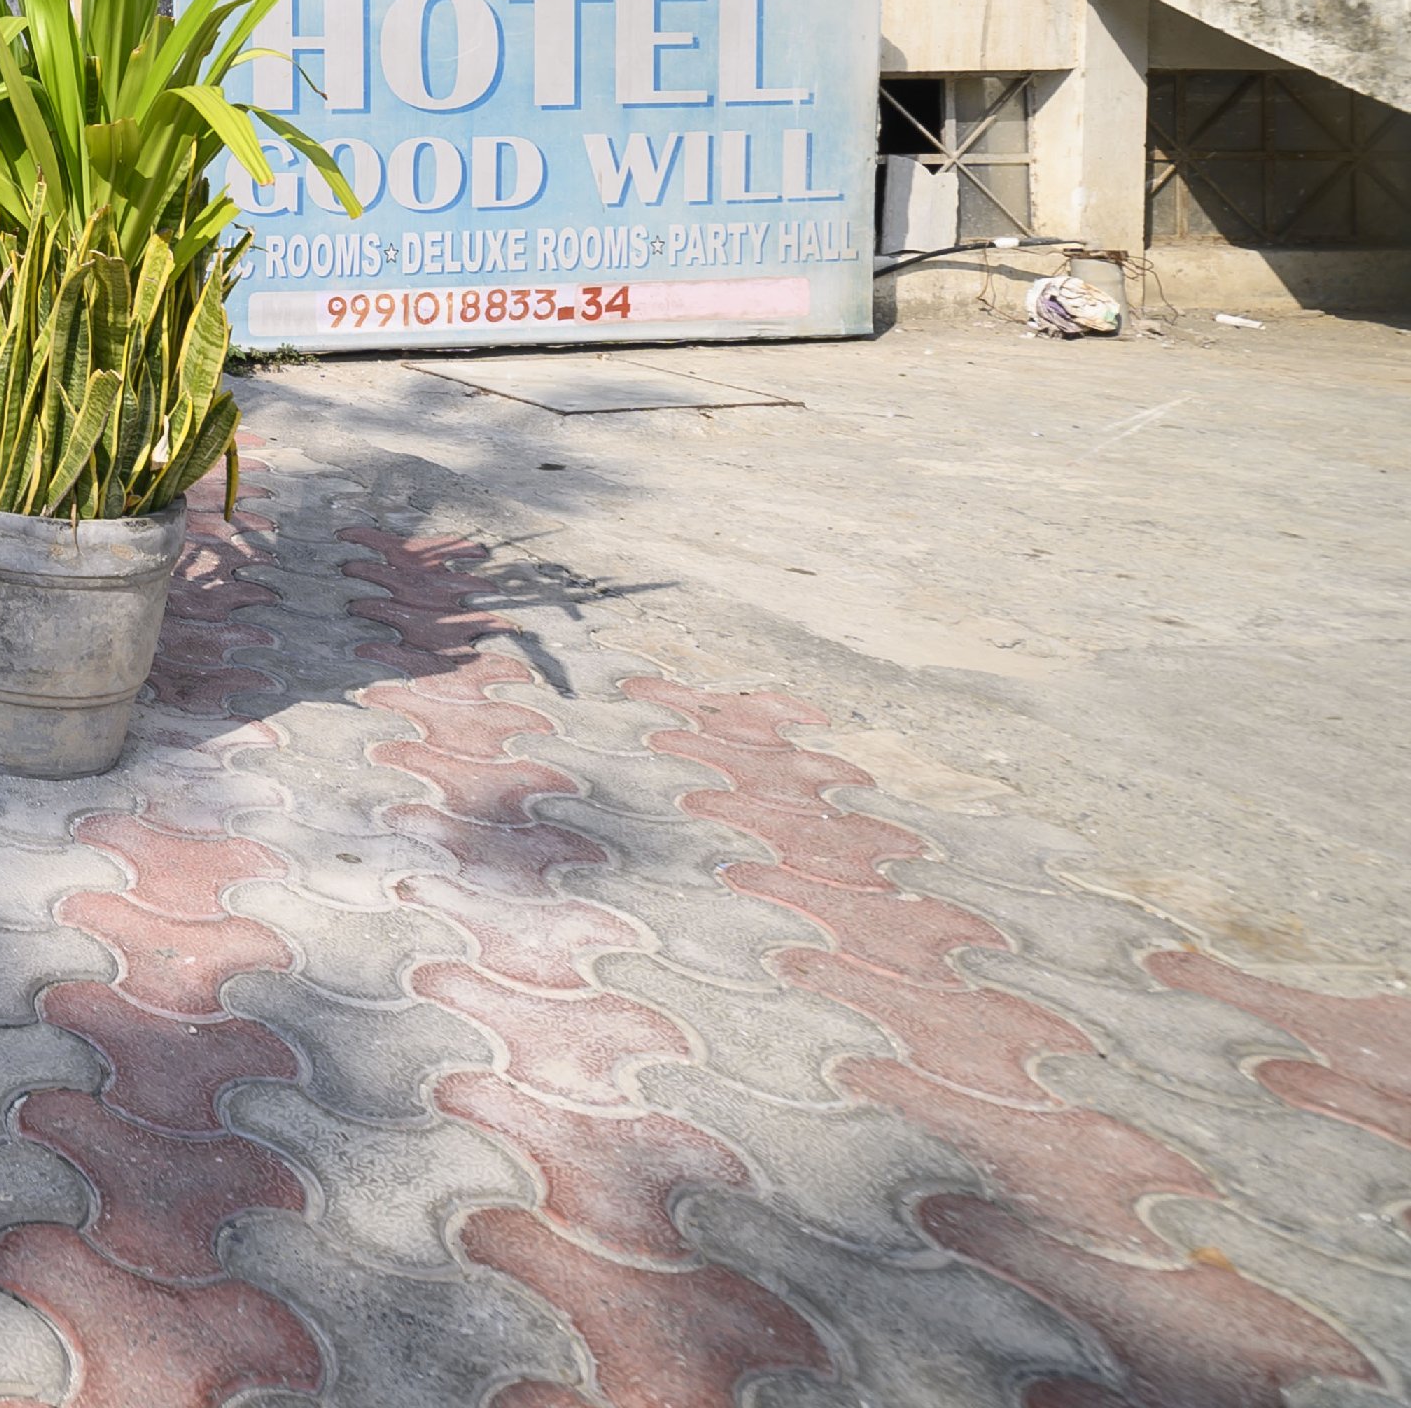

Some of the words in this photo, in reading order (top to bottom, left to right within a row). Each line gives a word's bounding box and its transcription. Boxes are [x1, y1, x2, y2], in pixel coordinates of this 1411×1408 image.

[225, 135, 549, 217] GOOD
[584, 129, 846, 207] WILL
[265, 230, 383, 279] ROOMS
[401, 227, 528, 277] DELUXE
[537, 225, 650, 272] ROOMS
[668, 221, 770, 267] PARTY
[779, 219, 859, 264] HALL
